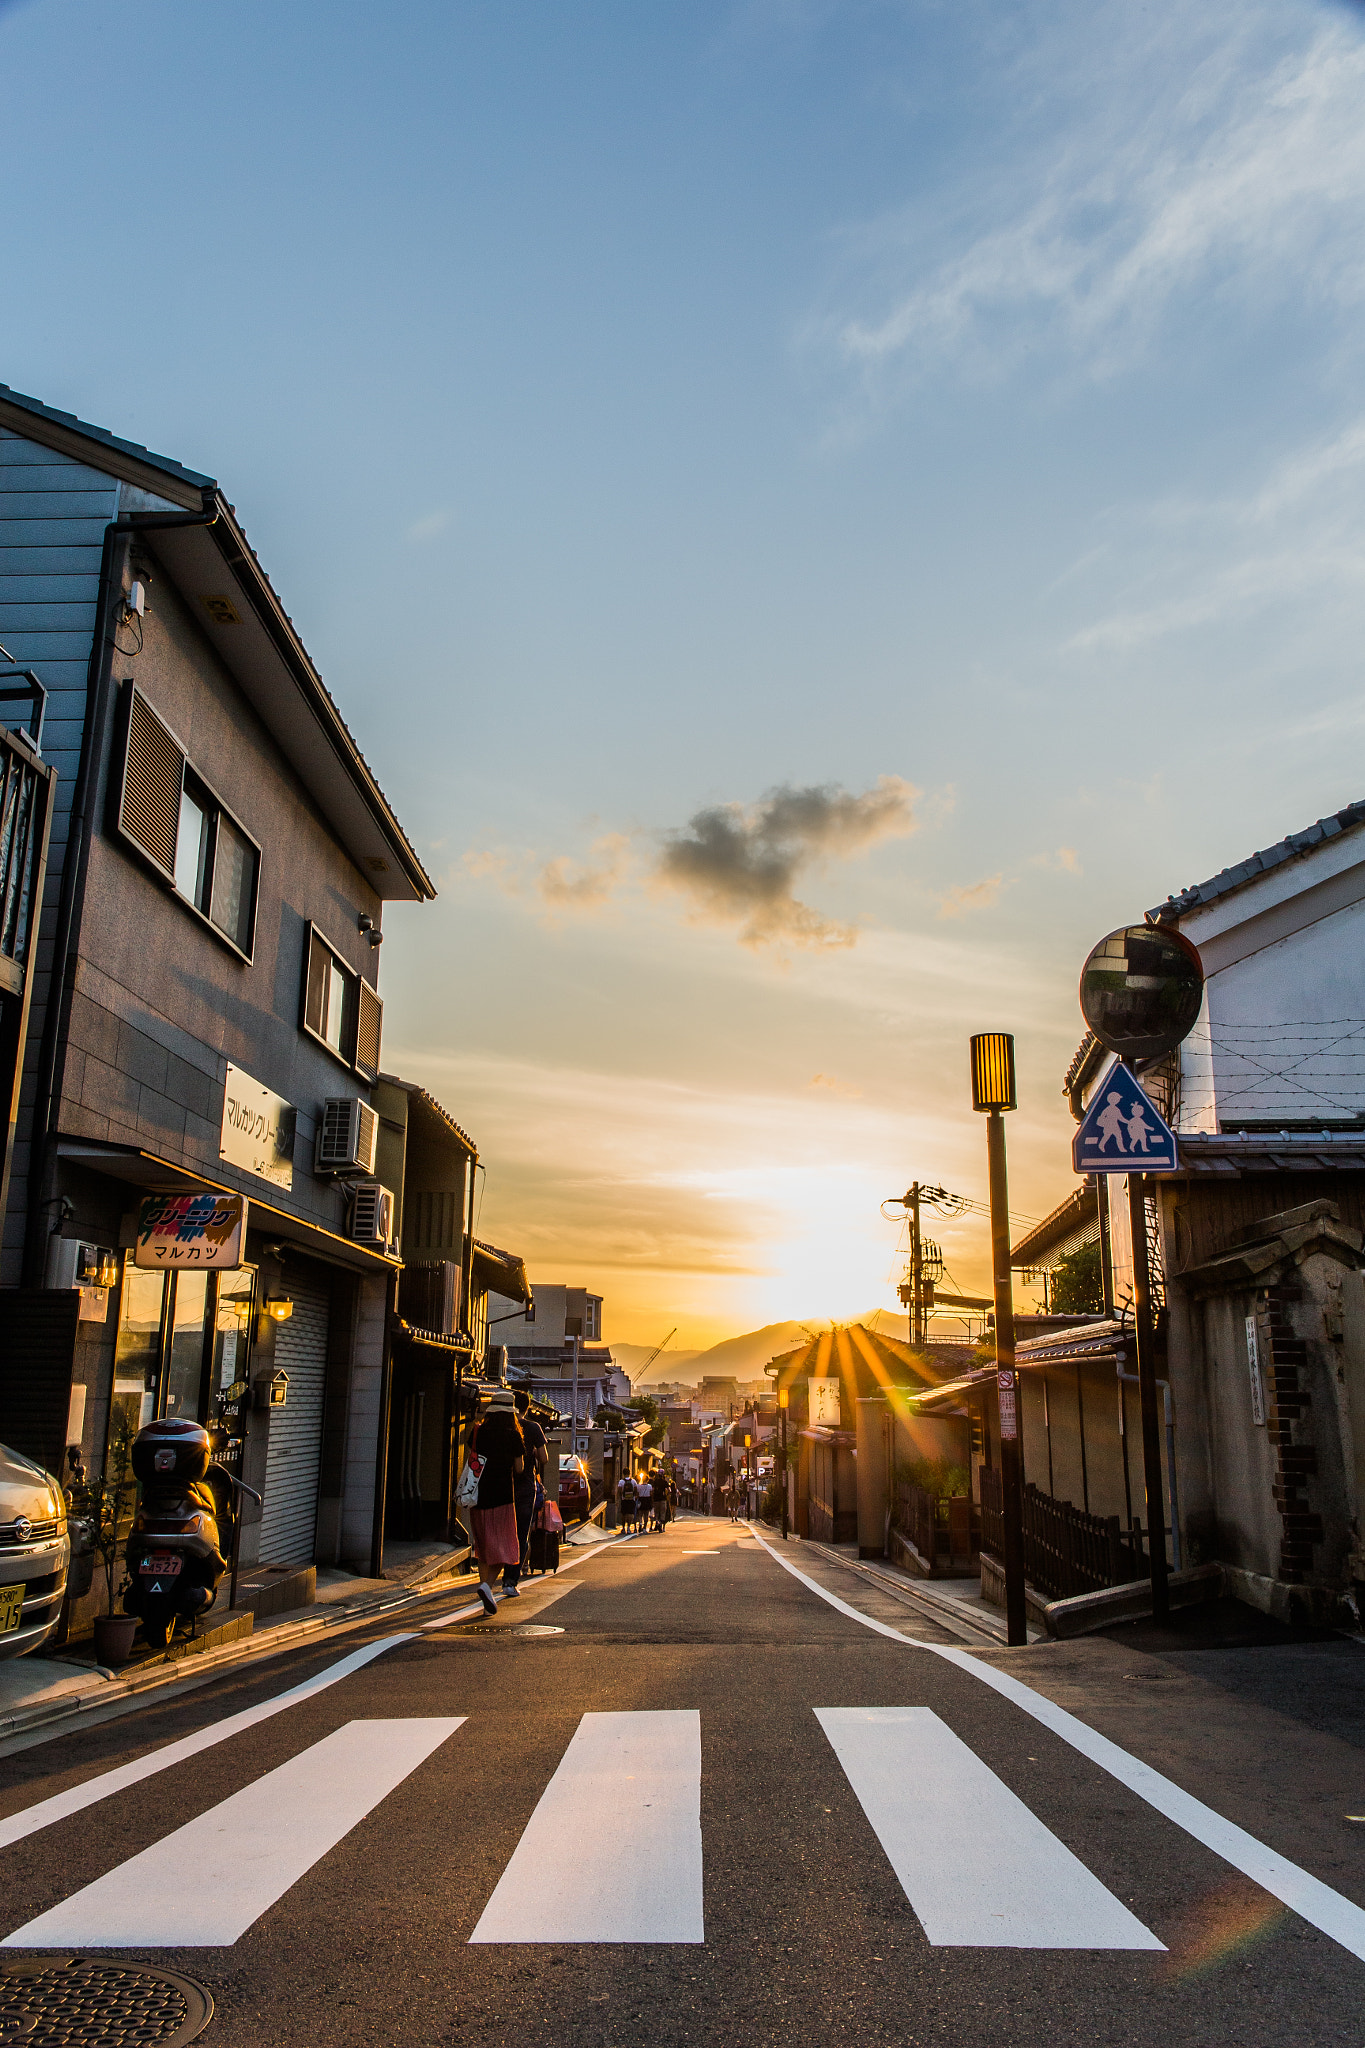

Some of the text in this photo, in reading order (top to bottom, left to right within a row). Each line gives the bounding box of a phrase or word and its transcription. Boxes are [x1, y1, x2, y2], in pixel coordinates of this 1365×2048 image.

[144, 1209, 236, 1227] クリーニング
[154, 1246, 218, 1260] マルカツ
[758, 1468, 766, 1476] P
